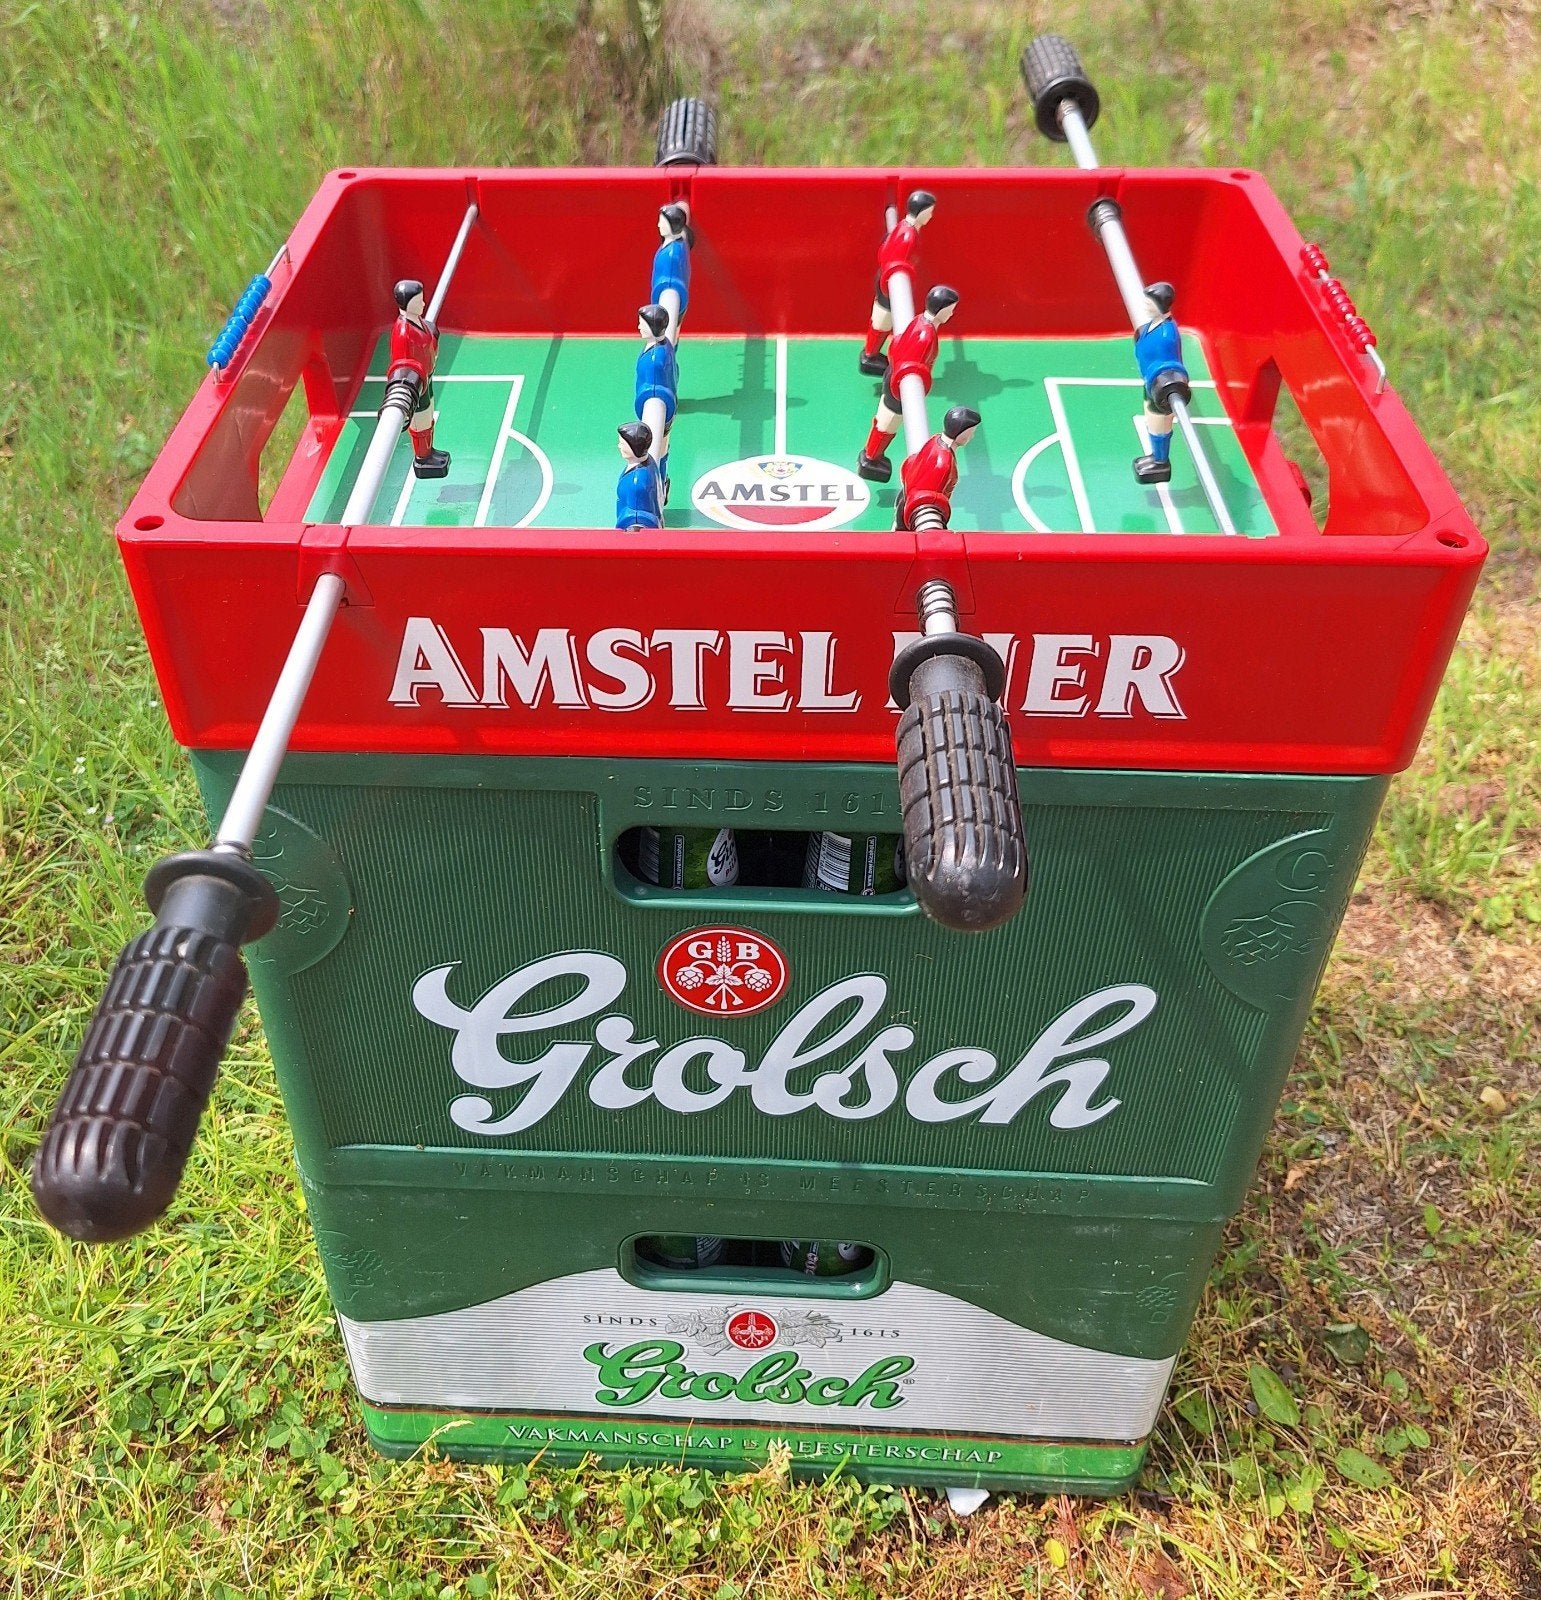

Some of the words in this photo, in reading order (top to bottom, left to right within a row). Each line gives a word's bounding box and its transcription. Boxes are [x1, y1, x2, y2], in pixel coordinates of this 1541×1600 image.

[697, 481, 866, 502] AMSTEL
[387, 616, 862, 714] AMSTEL
[884, 630, 1187, 721] ER
[632, 785, 785, 813] SINDS
[812, 791, 903, 816] 161
[687, 941, 714, 959] G
[735, 942, 760, 960] B
[411, 950, 1157, 1136] Grolsch
[583, 1314, 658, 1327] SINDS
[851, 1327, 901, 1338] 1615
[583, 1340, 916, 1408] Grolsch
[507, 1424, 734, 1451] VAKMANSCHAP
